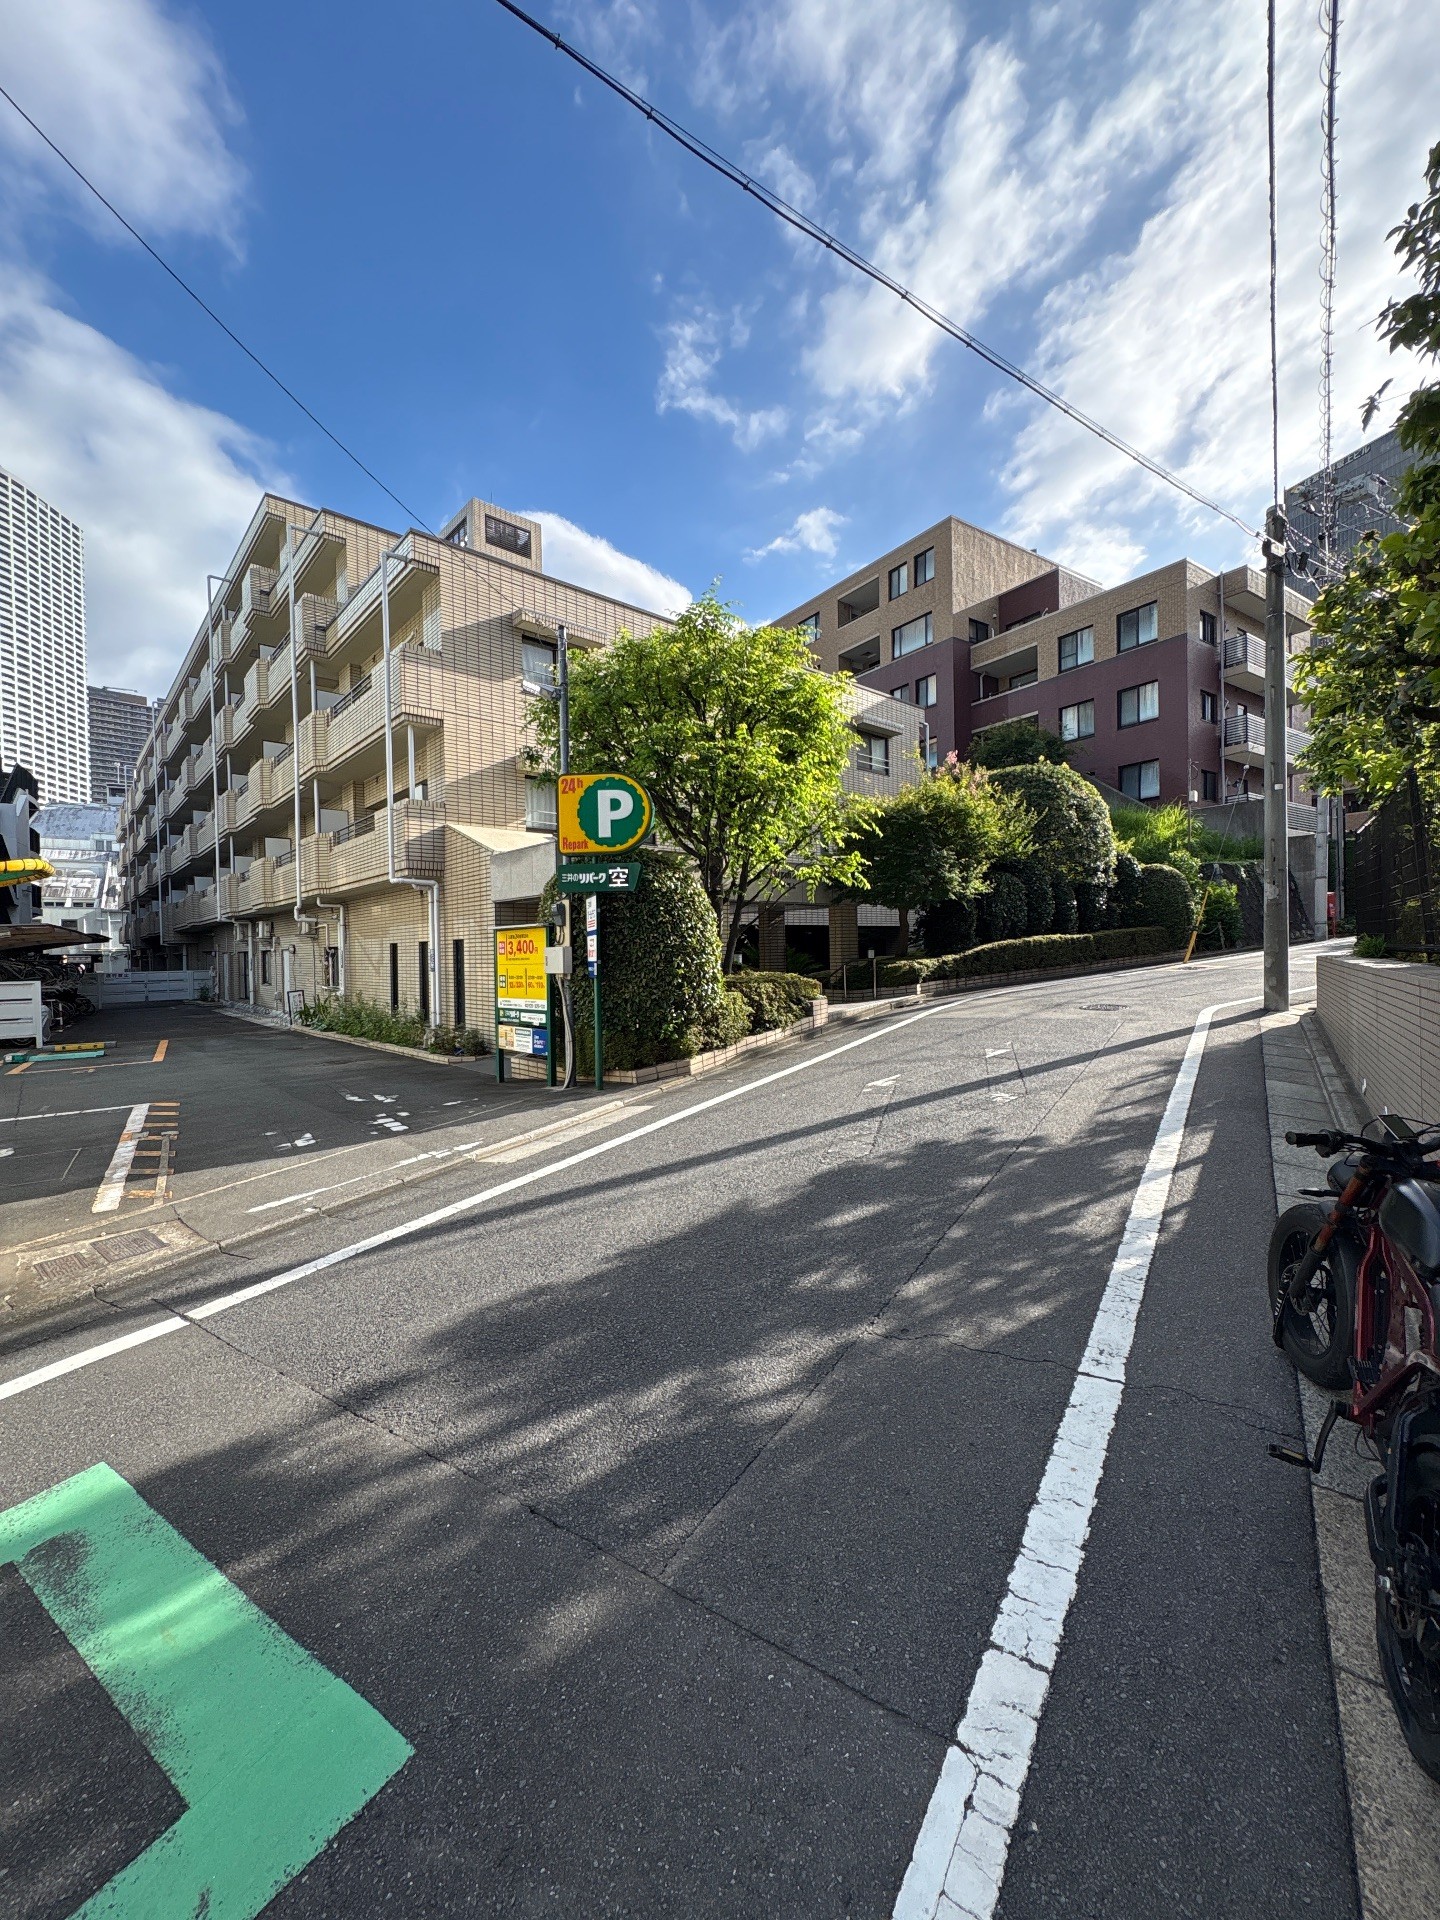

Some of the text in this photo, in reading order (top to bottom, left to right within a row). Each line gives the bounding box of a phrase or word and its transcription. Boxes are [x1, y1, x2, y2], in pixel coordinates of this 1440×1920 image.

[561, 778, 584, 795] 24h
[597, 789, 634, 838] P
[562, 837, 589, 851] Repark
[561, 866, 629, 887] 三井のリパーク 空
